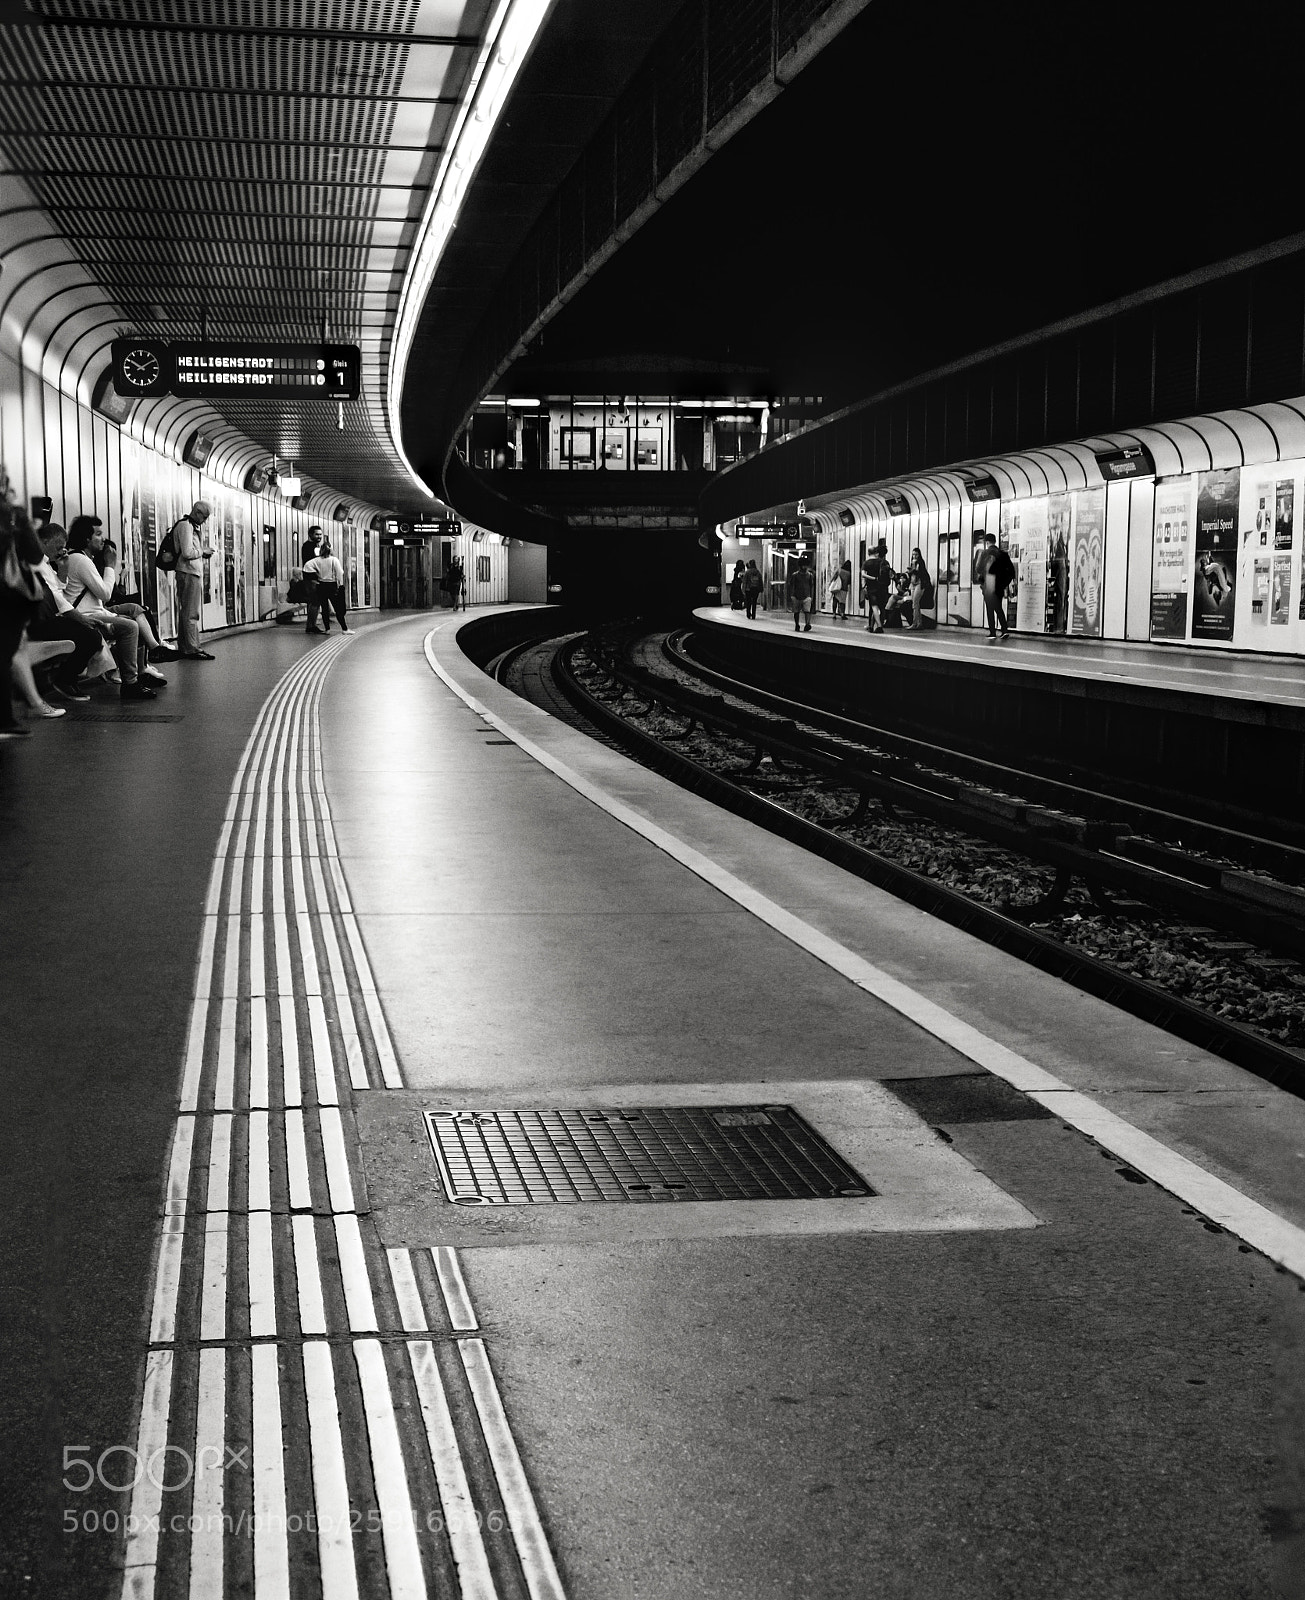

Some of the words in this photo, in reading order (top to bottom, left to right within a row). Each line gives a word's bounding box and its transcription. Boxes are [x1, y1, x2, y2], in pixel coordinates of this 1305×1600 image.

[178, 356, 274, 369] HEILIGENSTADT
[178, 373, 274, 386] HEILIGENSTADT
[337, 371, 344, 386] 1
[1201, 518, 1219, 533] Imperial
[1220, 518, 1234, 533] Speed
